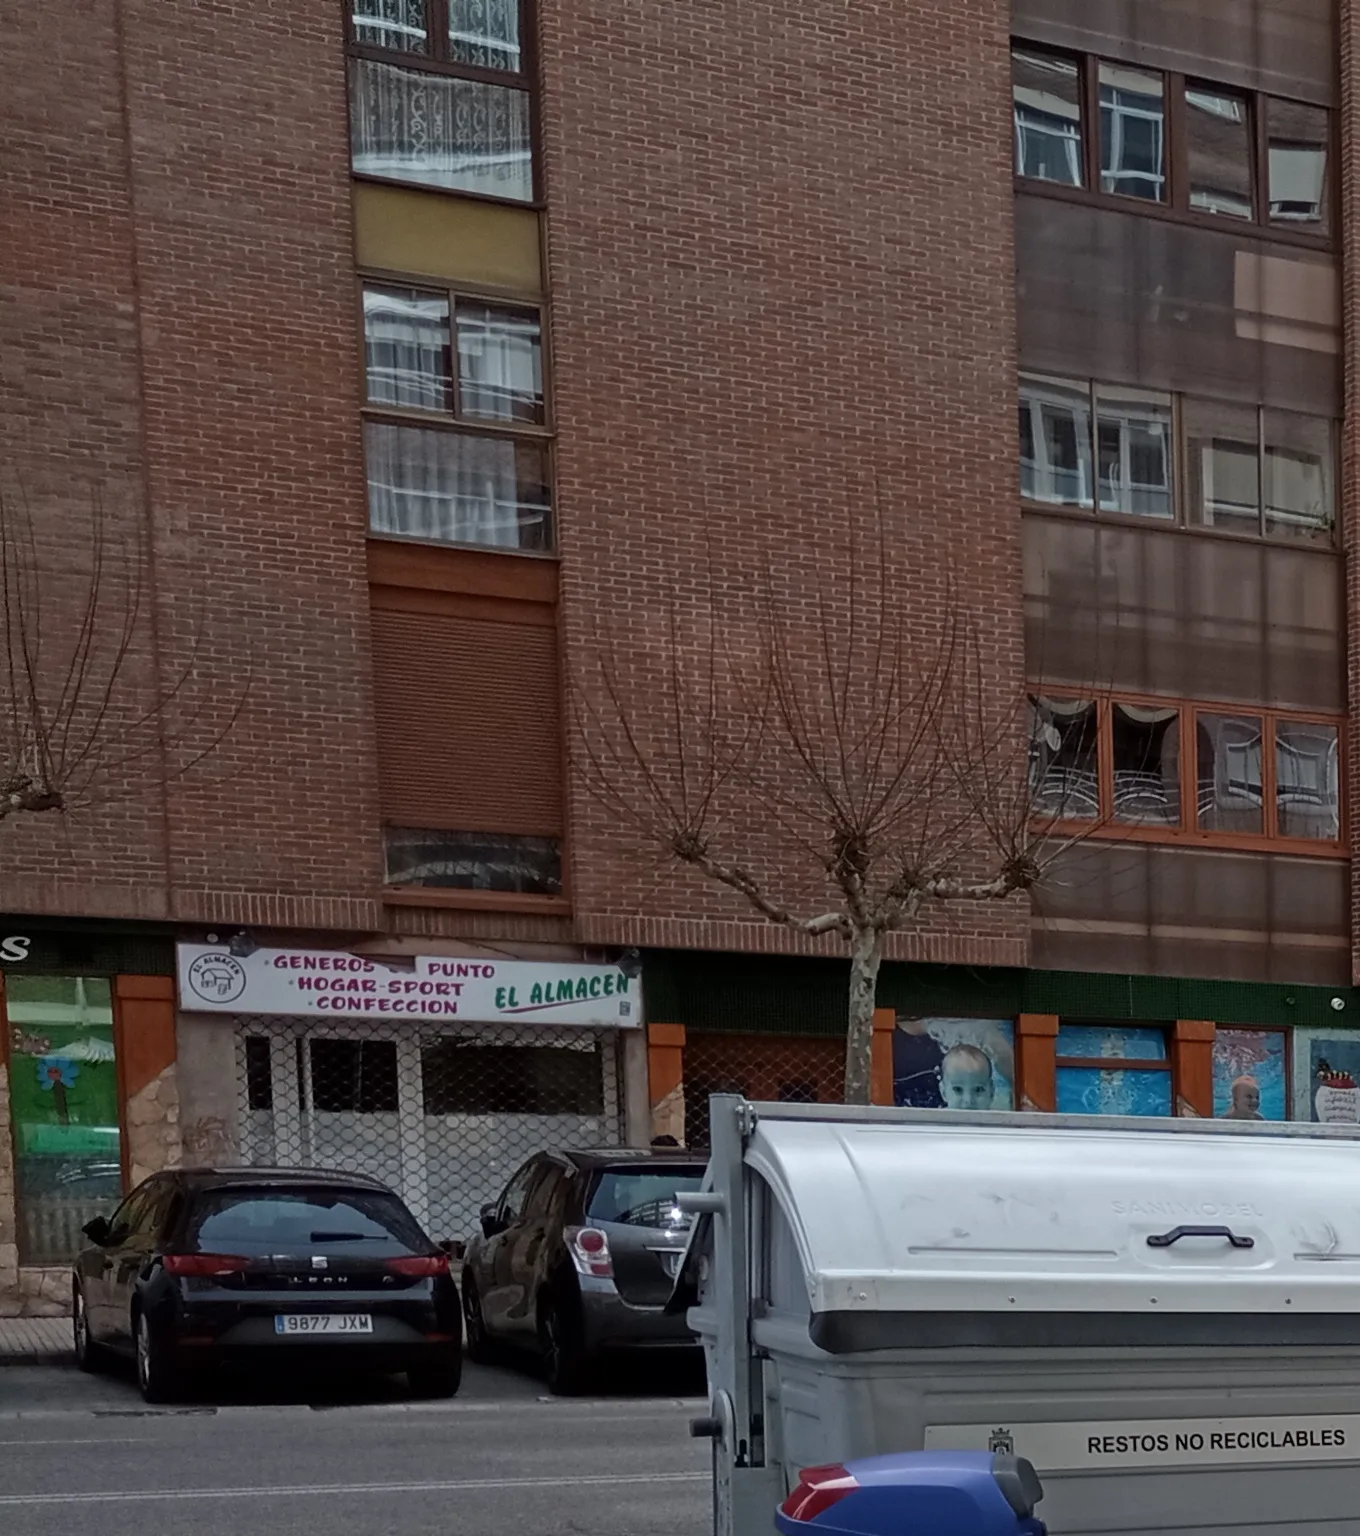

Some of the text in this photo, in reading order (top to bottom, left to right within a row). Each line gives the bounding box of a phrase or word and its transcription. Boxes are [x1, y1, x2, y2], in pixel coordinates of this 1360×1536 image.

[273, 955, 495, 979] GENEROS PUNTO
[495, 973, 629, 1009] EL ALMACEN
[316, 996, 458, 1014] CONFECCION
[288, 1316, 369, 1331] 9877 JXM
[1087, 1429, 1346, 1454] RESTOS NO RECICLABLES
